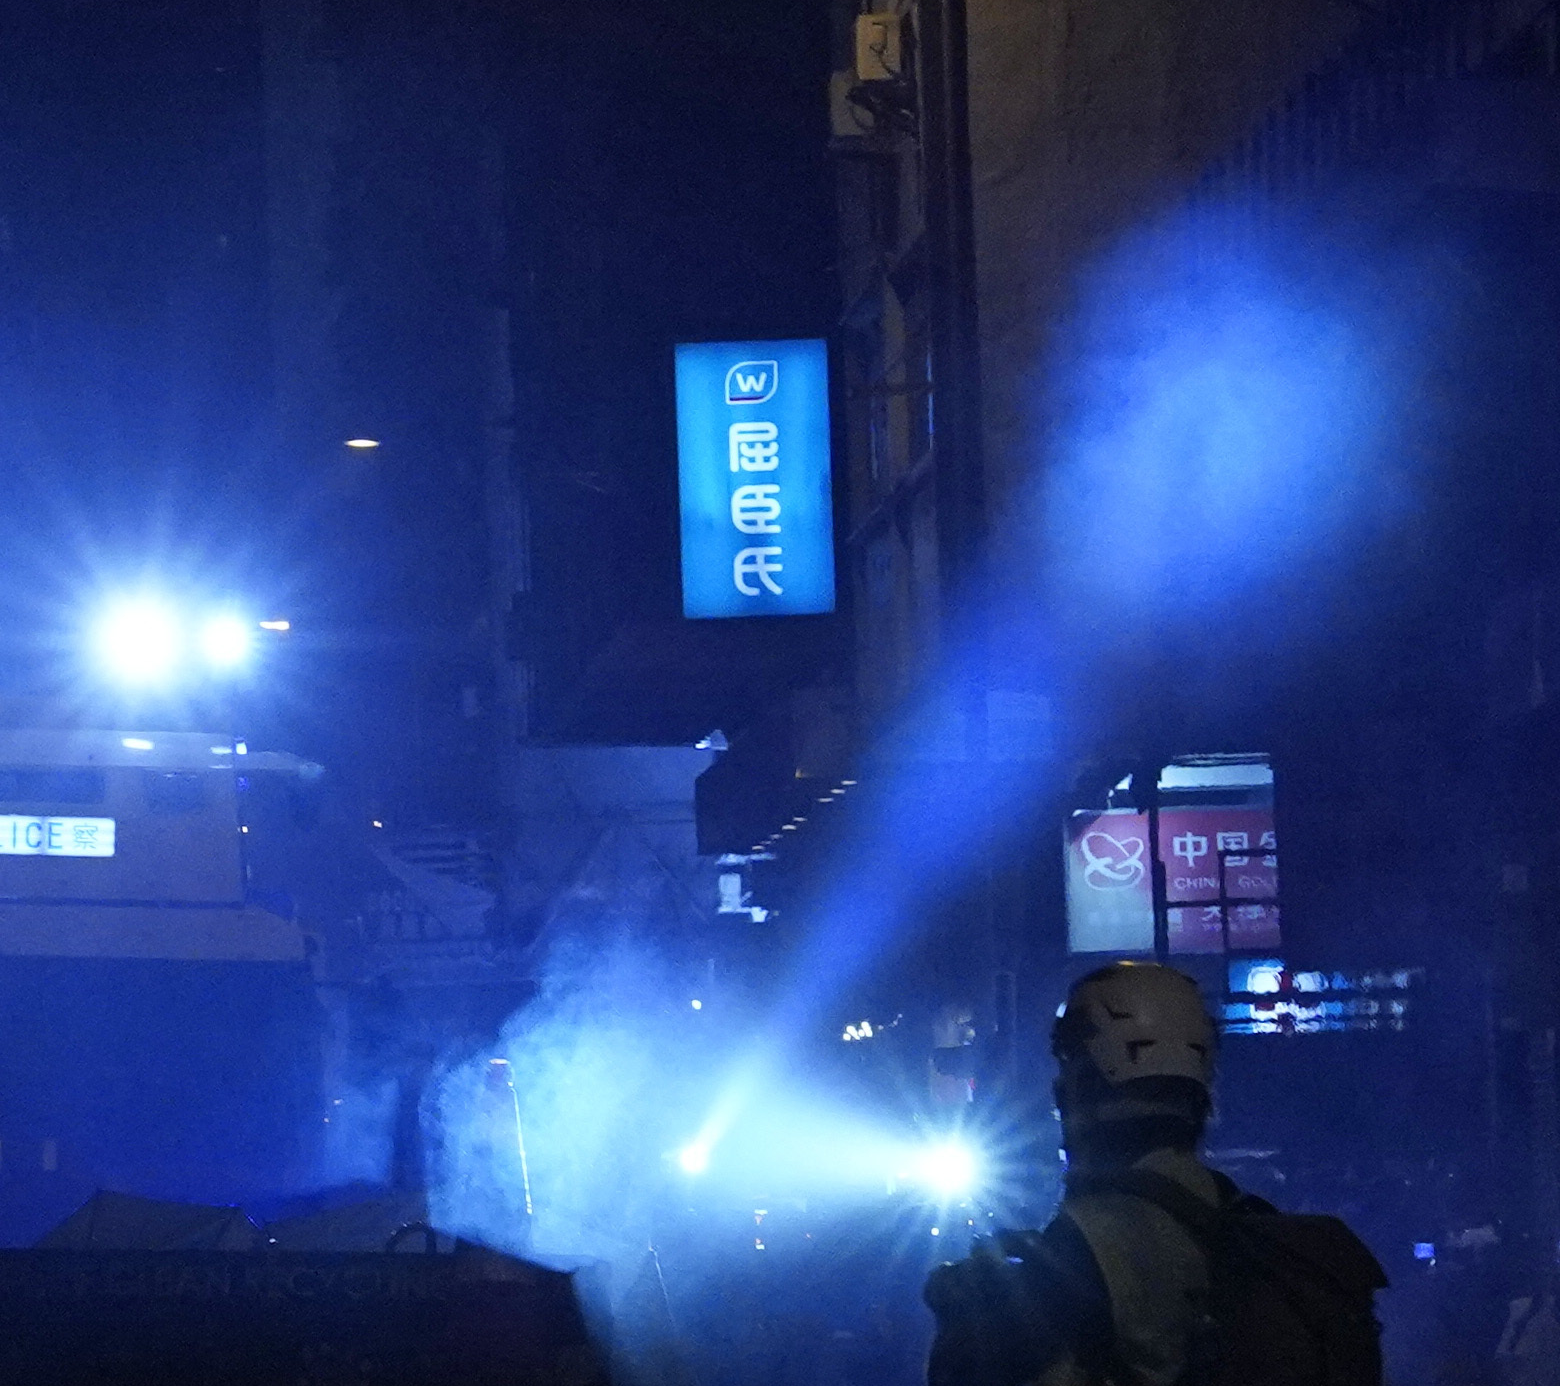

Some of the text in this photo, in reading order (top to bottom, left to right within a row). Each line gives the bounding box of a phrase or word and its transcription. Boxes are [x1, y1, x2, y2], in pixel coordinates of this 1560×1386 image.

[728, 420, 784, 597] 屈臣氏
[71, 822, 99, 851] 察
[1174, 875, 1220, 891] CHIN
